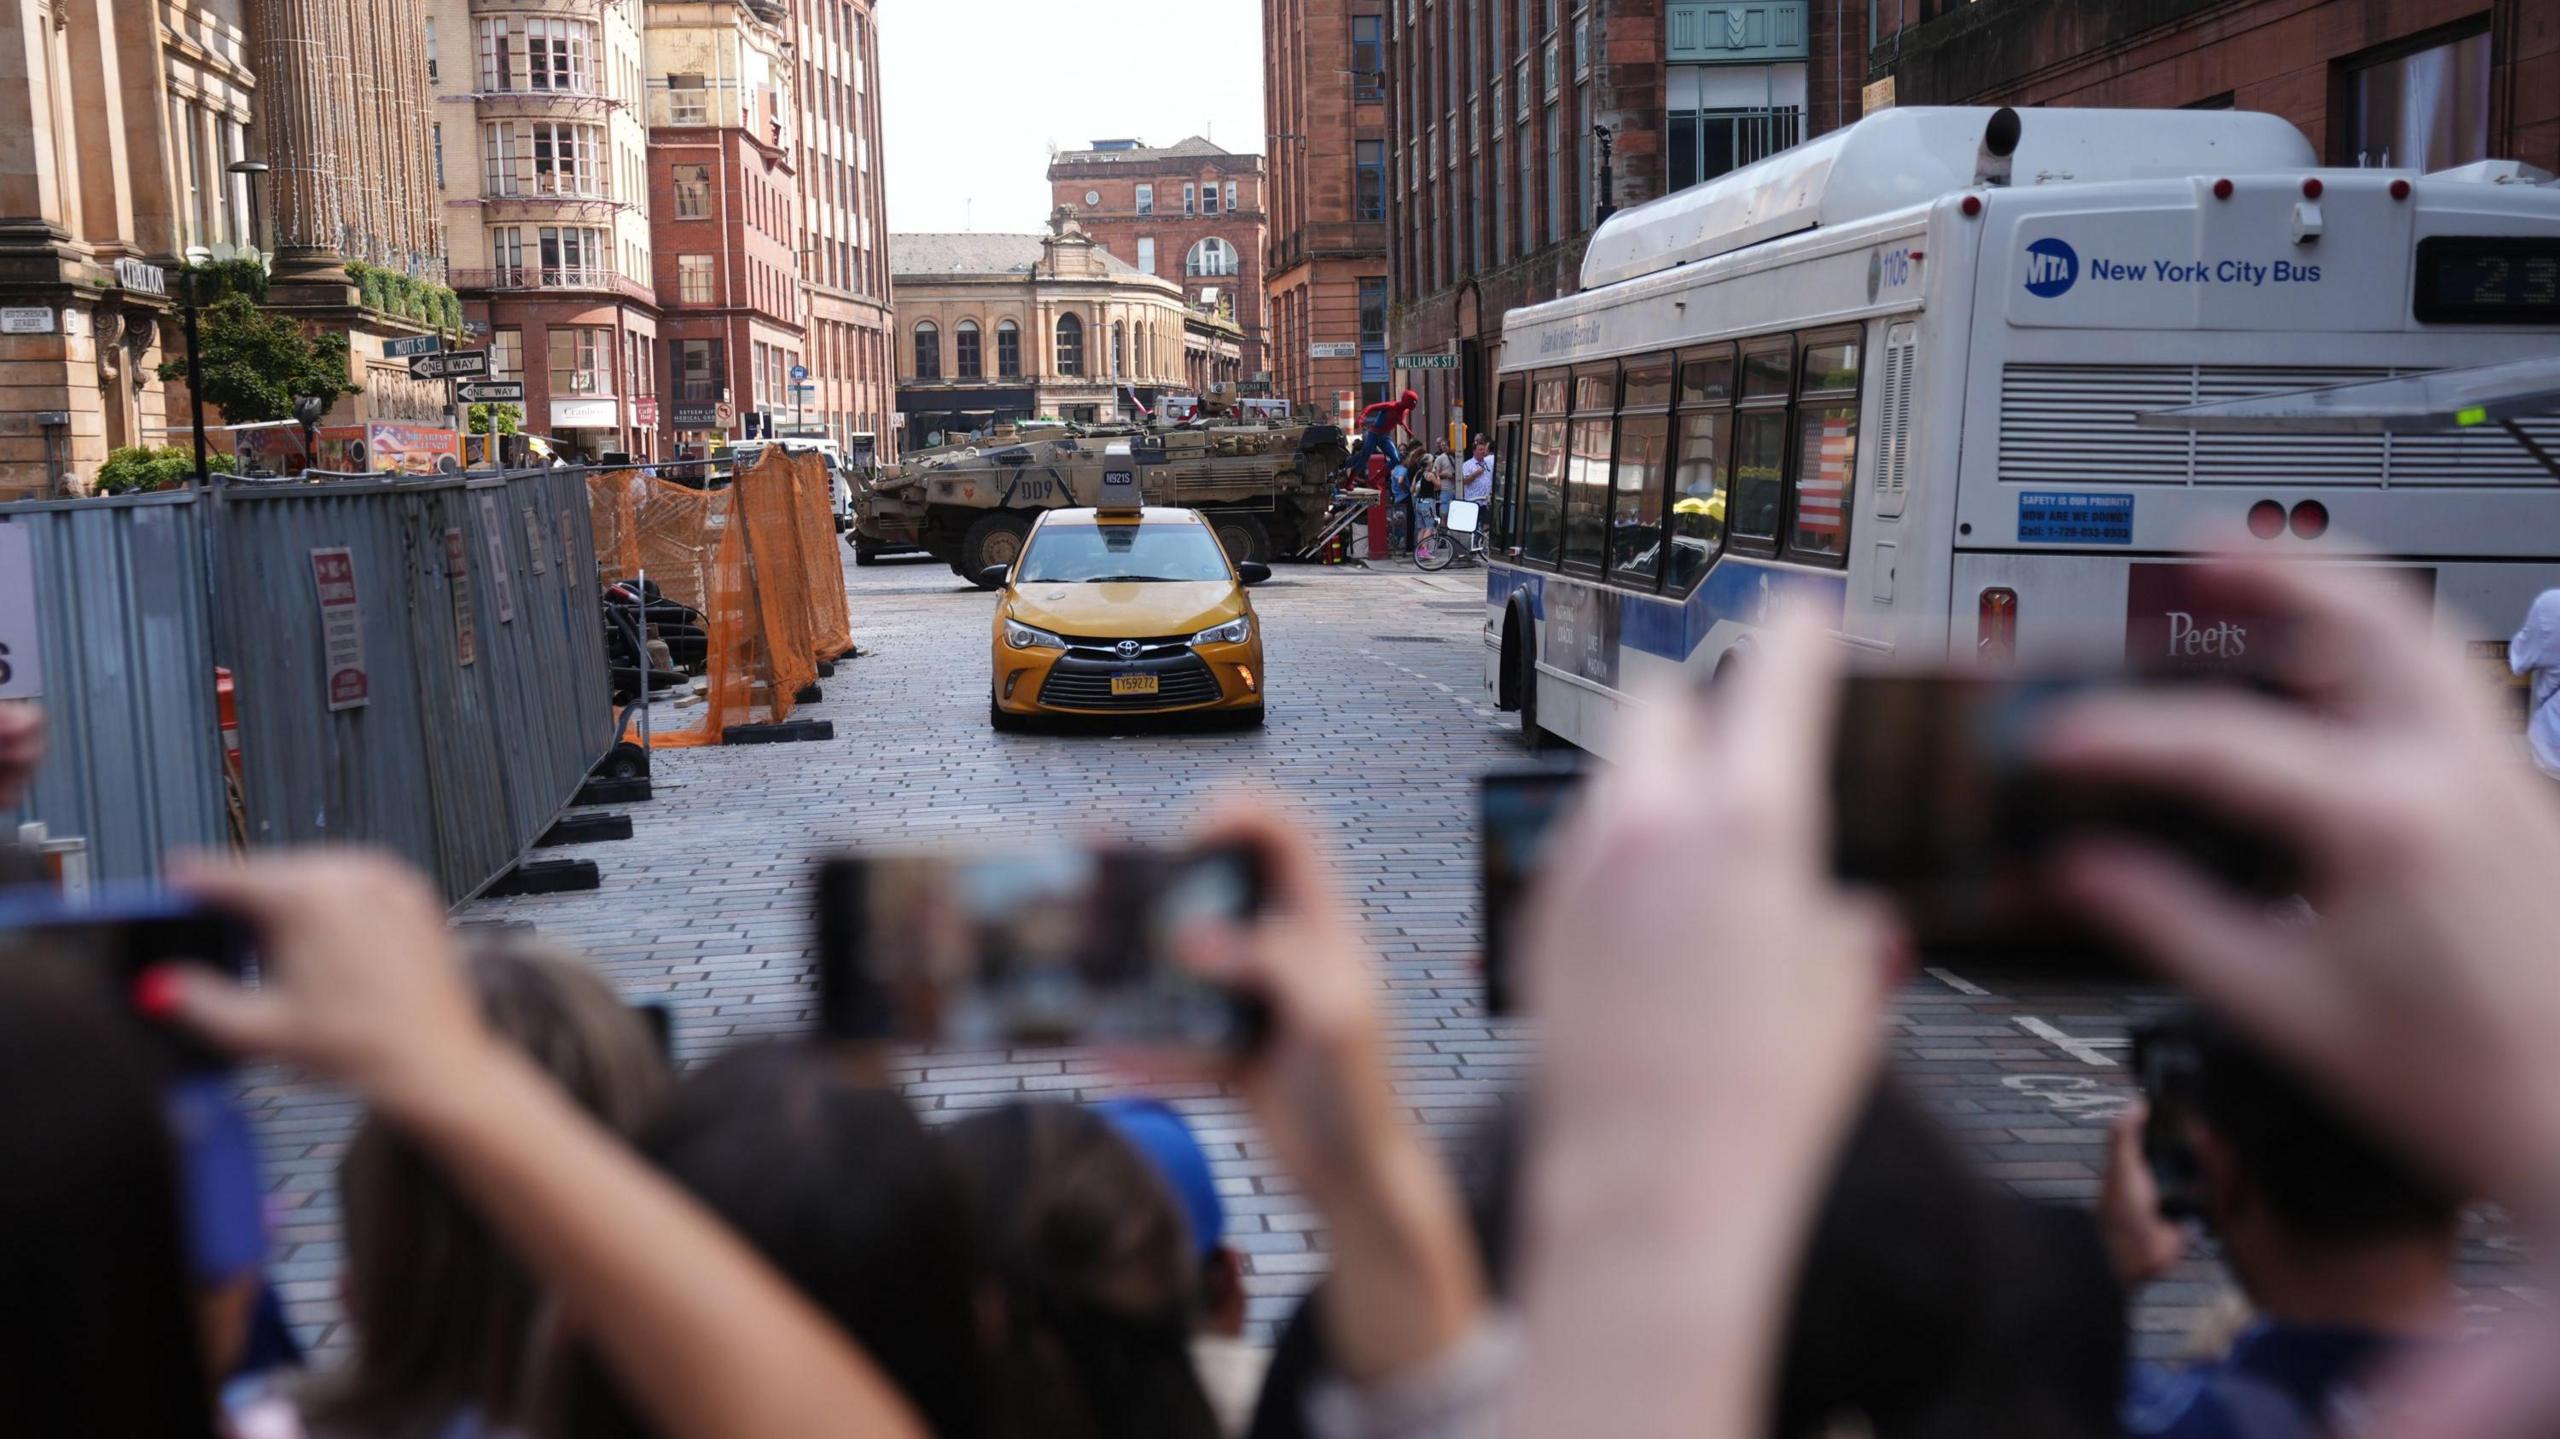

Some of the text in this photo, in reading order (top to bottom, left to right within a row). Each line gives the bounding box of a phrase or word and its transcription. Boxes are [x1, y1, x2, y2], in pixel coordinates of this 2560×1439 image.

[1884, 248, 1908, 288] 1106
[2027, 251, 2070, 284] MTA
[2091, 259, 2321, 286] New York City Bus
[395, 338, 426, 355] MOTT ST
[421, 359, 475, 373] ONE WAY
[1397, 356, 1452, 368] WILLIAMS ST
[467, 387, 513, 397] ONE WAY
[2022, 495, 2056, 505] SAFETY
[2058, 496, 2067, 505] IS
[2069, 496, 2087, 506] OUR
[2048, 511, 2069, 521] ARE
[2166, 612, 2247, 658] Peet's
